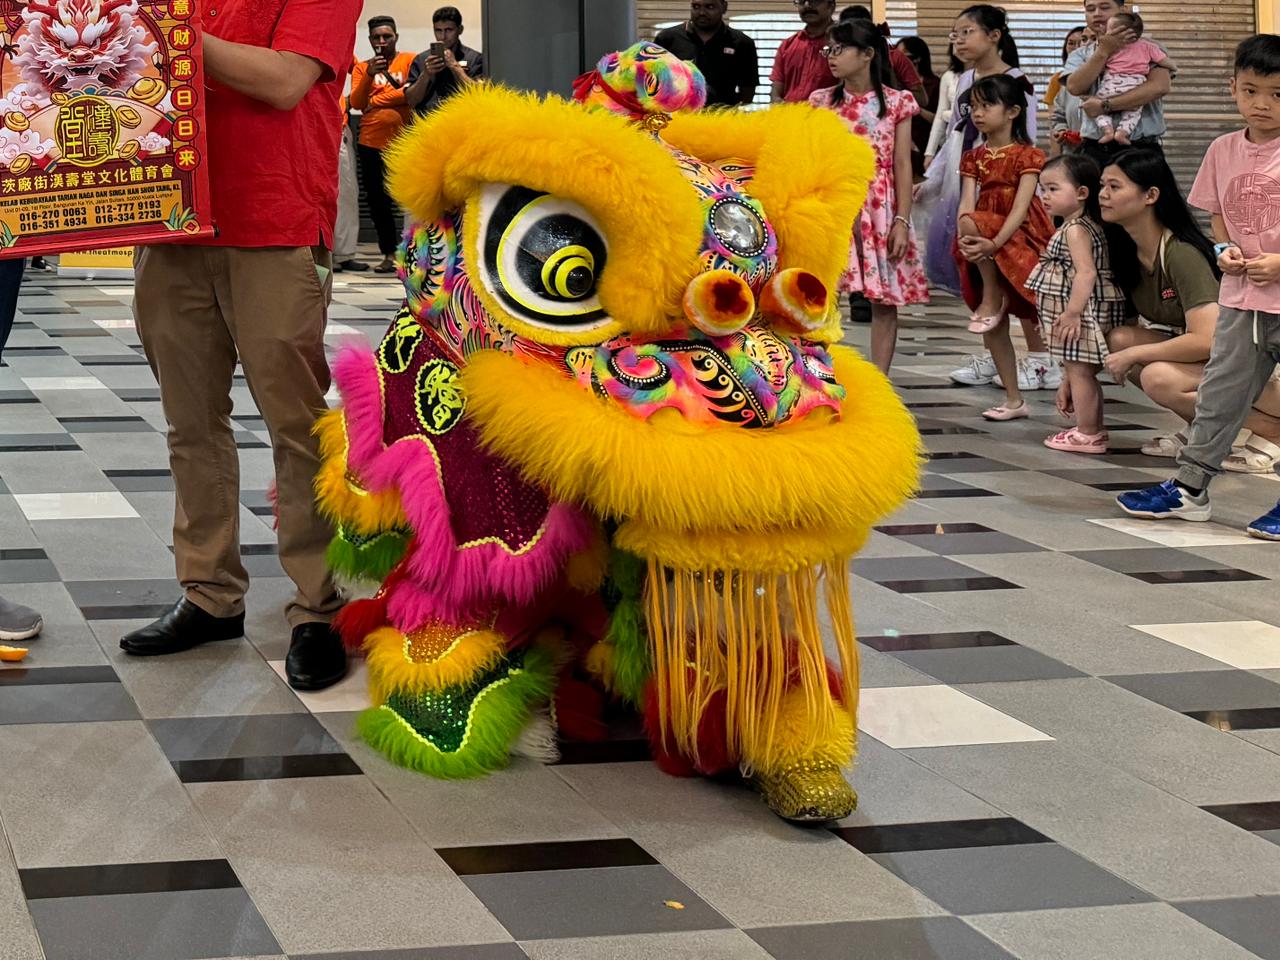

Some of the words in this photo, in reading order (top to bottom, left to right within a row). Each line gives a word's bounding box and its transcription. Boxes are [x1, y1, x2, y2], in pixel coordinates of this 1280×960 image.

[20, 209, 60, 222] 016-270
[62, 207, 87, 219] 0063
[94, 202, 135, 214] 012-777
[138, 200, 161, 210] 9193
[20, 219, 60, 232] 016-351
[63, 216, 88, 228] 4934
[95, 212, 135, 224] 016-334
[138, 210, 162, 220] 2736
